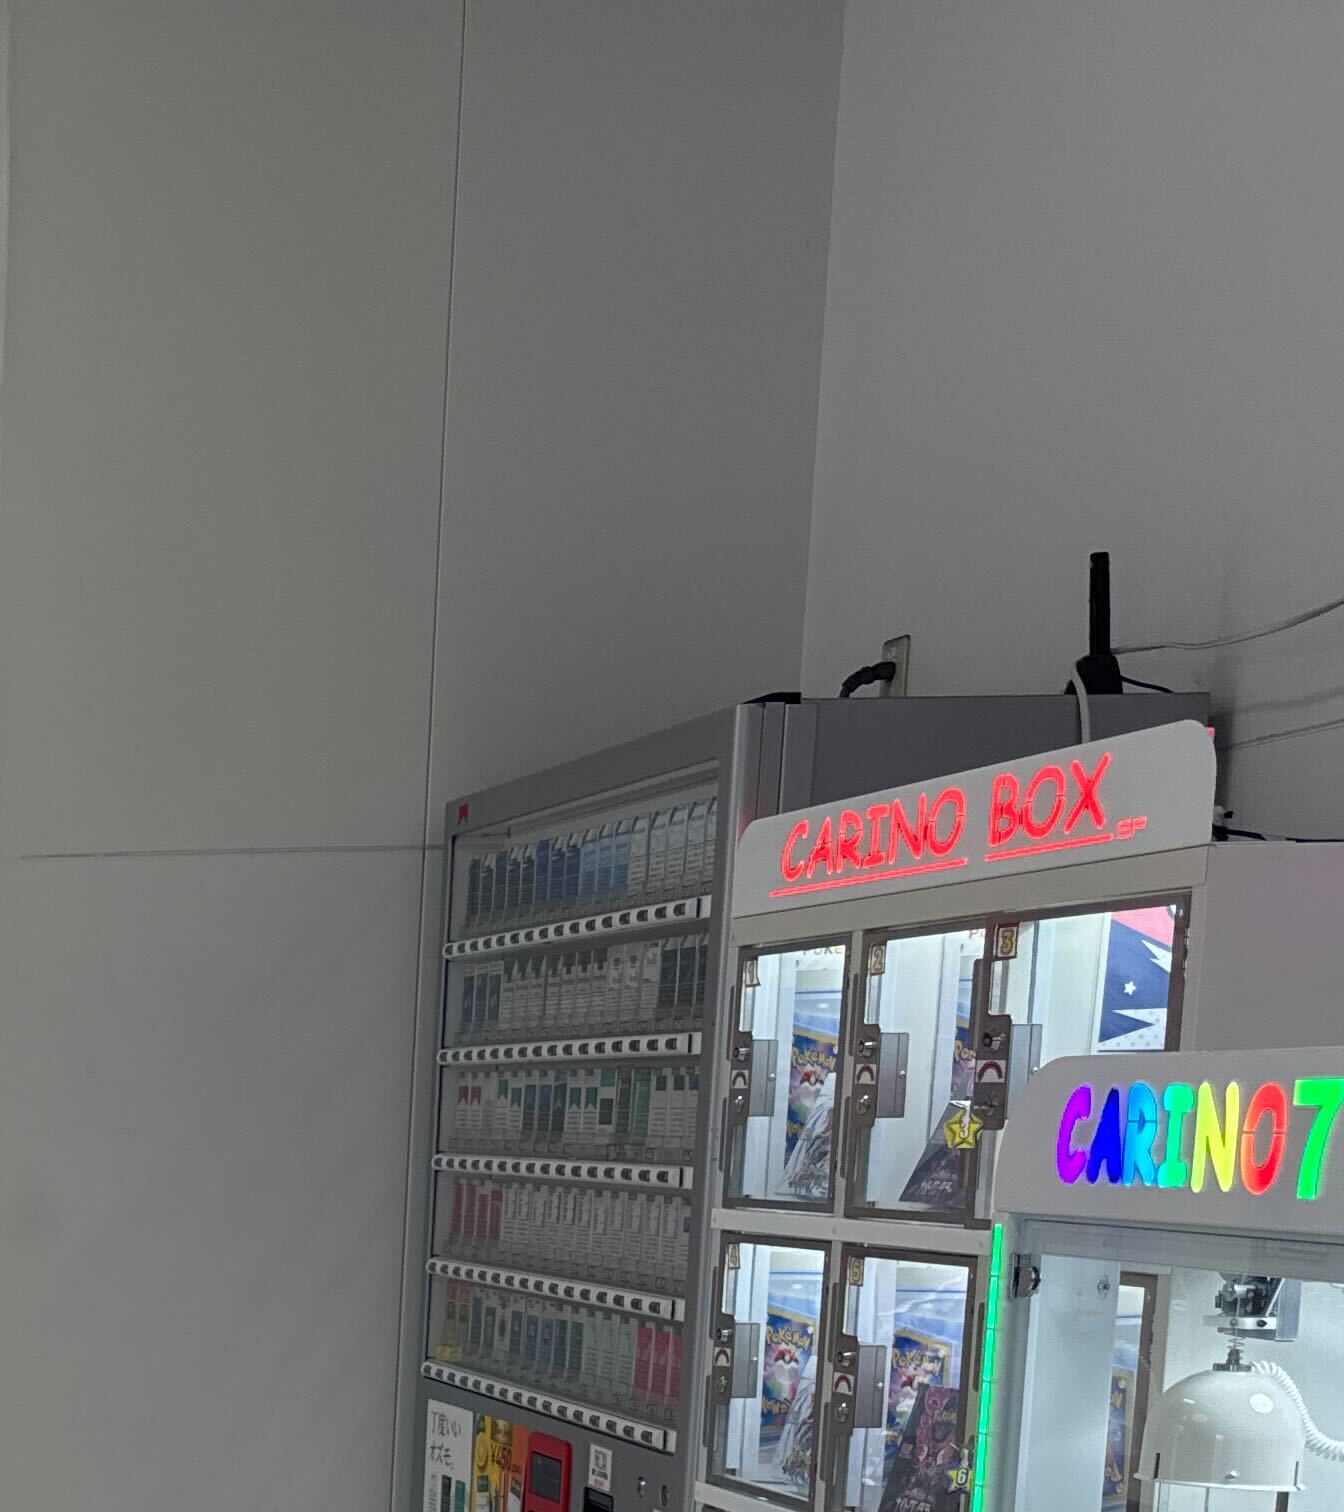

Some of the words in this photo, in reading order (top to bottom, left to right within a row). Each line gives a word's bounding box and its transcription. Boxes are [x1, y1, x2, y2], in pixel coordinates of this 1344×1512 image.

[780, 787, 967, 882] CARINO
[987, 751, 1112, 848] BOX
[1115, 815, 1148, 840] SP
[1000, 928, 1015, 956] 3
[872, 945, 884, 972] 2
